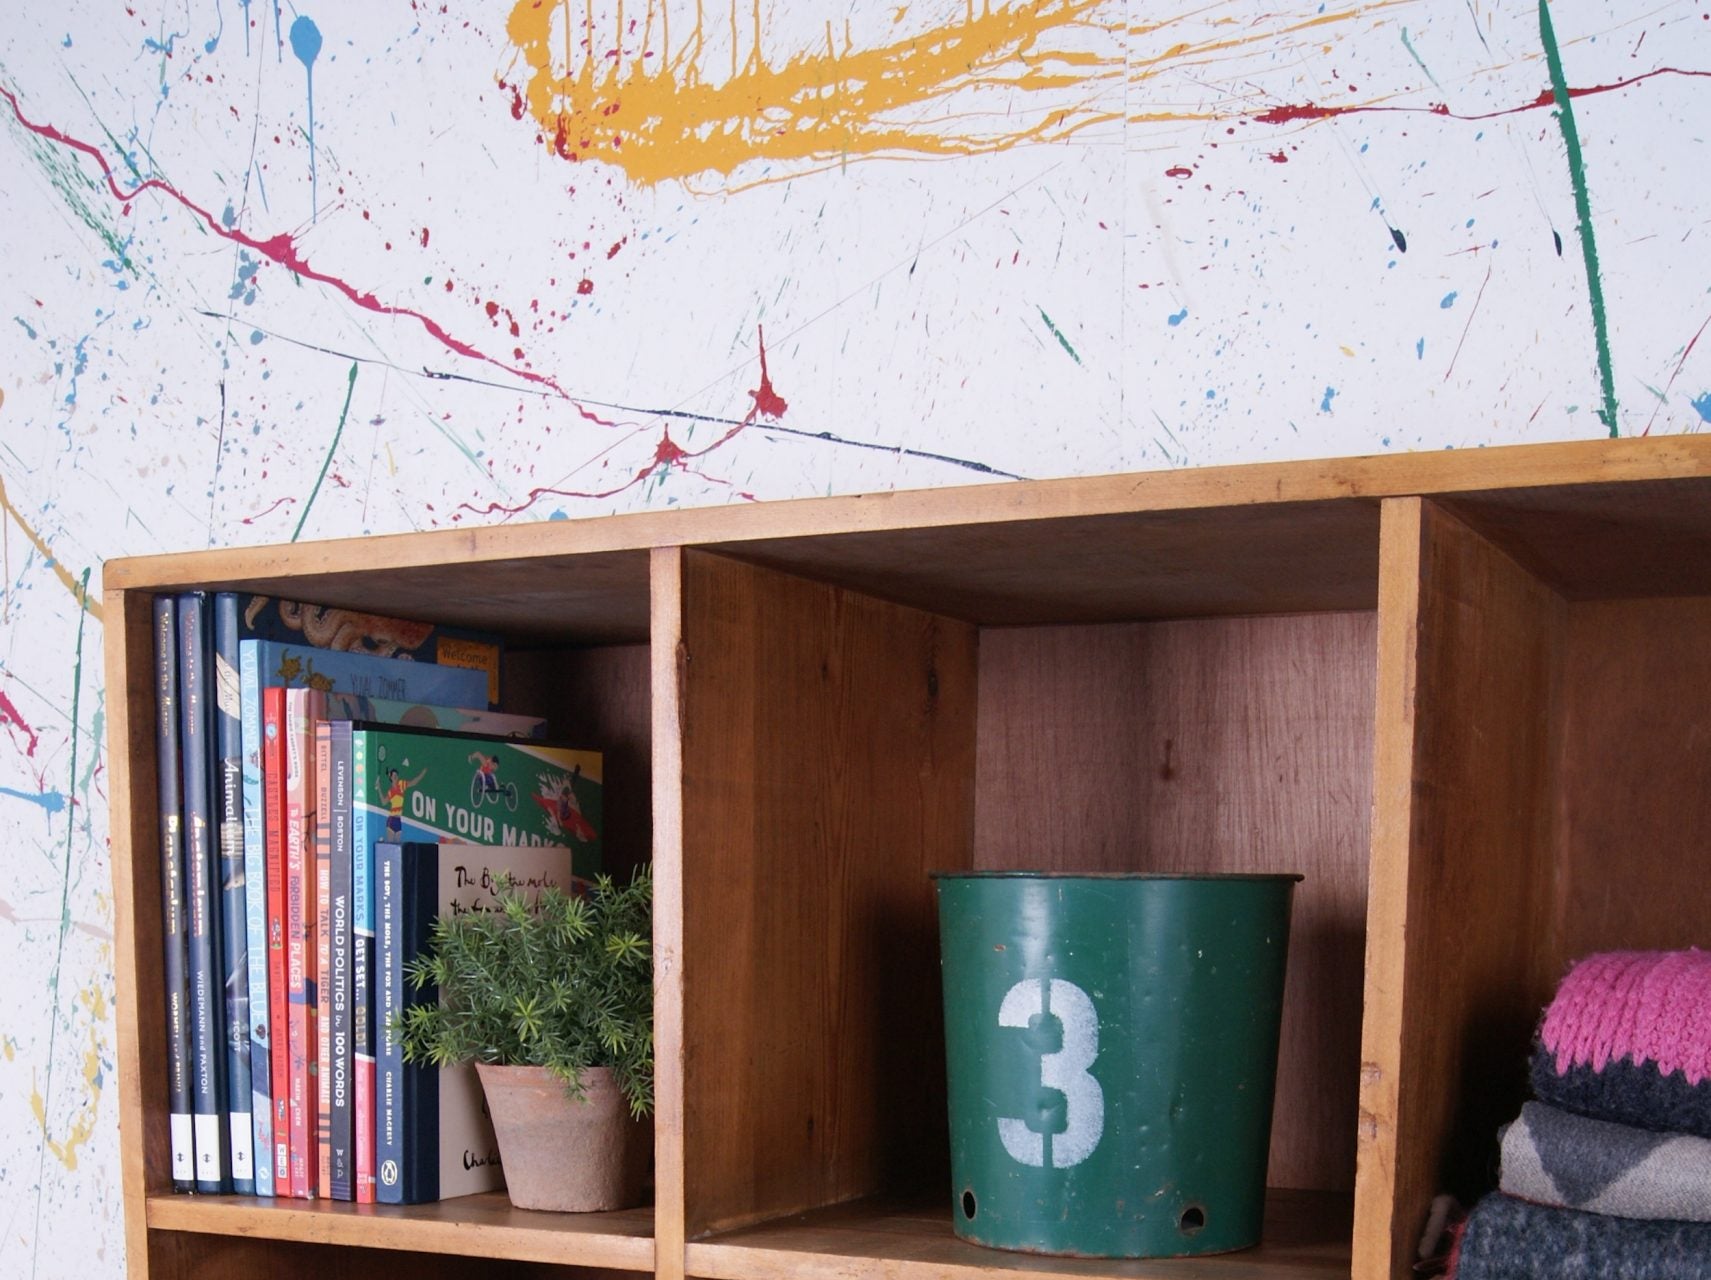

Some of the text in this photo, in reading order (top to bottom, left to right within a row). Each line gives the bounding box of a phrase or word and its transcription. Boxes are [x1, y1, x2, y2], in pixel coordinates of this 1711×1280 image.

[243, 649, 257, 690] YUVAL
[443, 646, 488, 666] Welcome
[337, 761, 345, 807] LEVENSON
[355, 815, 364, 832] ON
[411, 789, 436, 822] ON
[446, 802, 495, 843] YOUR
[289, 818, 302, 870] EARTH'S
[355, 836, 364, 875] YOUR
[454, 866, 476, 888] The
[320, 909, 330, 937] TALK
[335, 896, 345, 946] WORLD
[290, 942, 303, 989] PLACES
[355, 939, 366, 965] GET
[320, 970, 330, 1004] TIGER
[335, 947, 345, 1011] POLITICS
[384, 988, 392, 1008] AND
[196, 970, 206, 1032] WIEDEMANN
[250, 981, 267, 1022] BLUE
[335, 1032, 345, 1056] 100
[200, 1054, 208, 1094] PAXTON
[335, 1057, 345, 1108] WORDS
[385, 1072, 393, 1105] CHARLIE
[997, 978, 1105, 1169] 3
